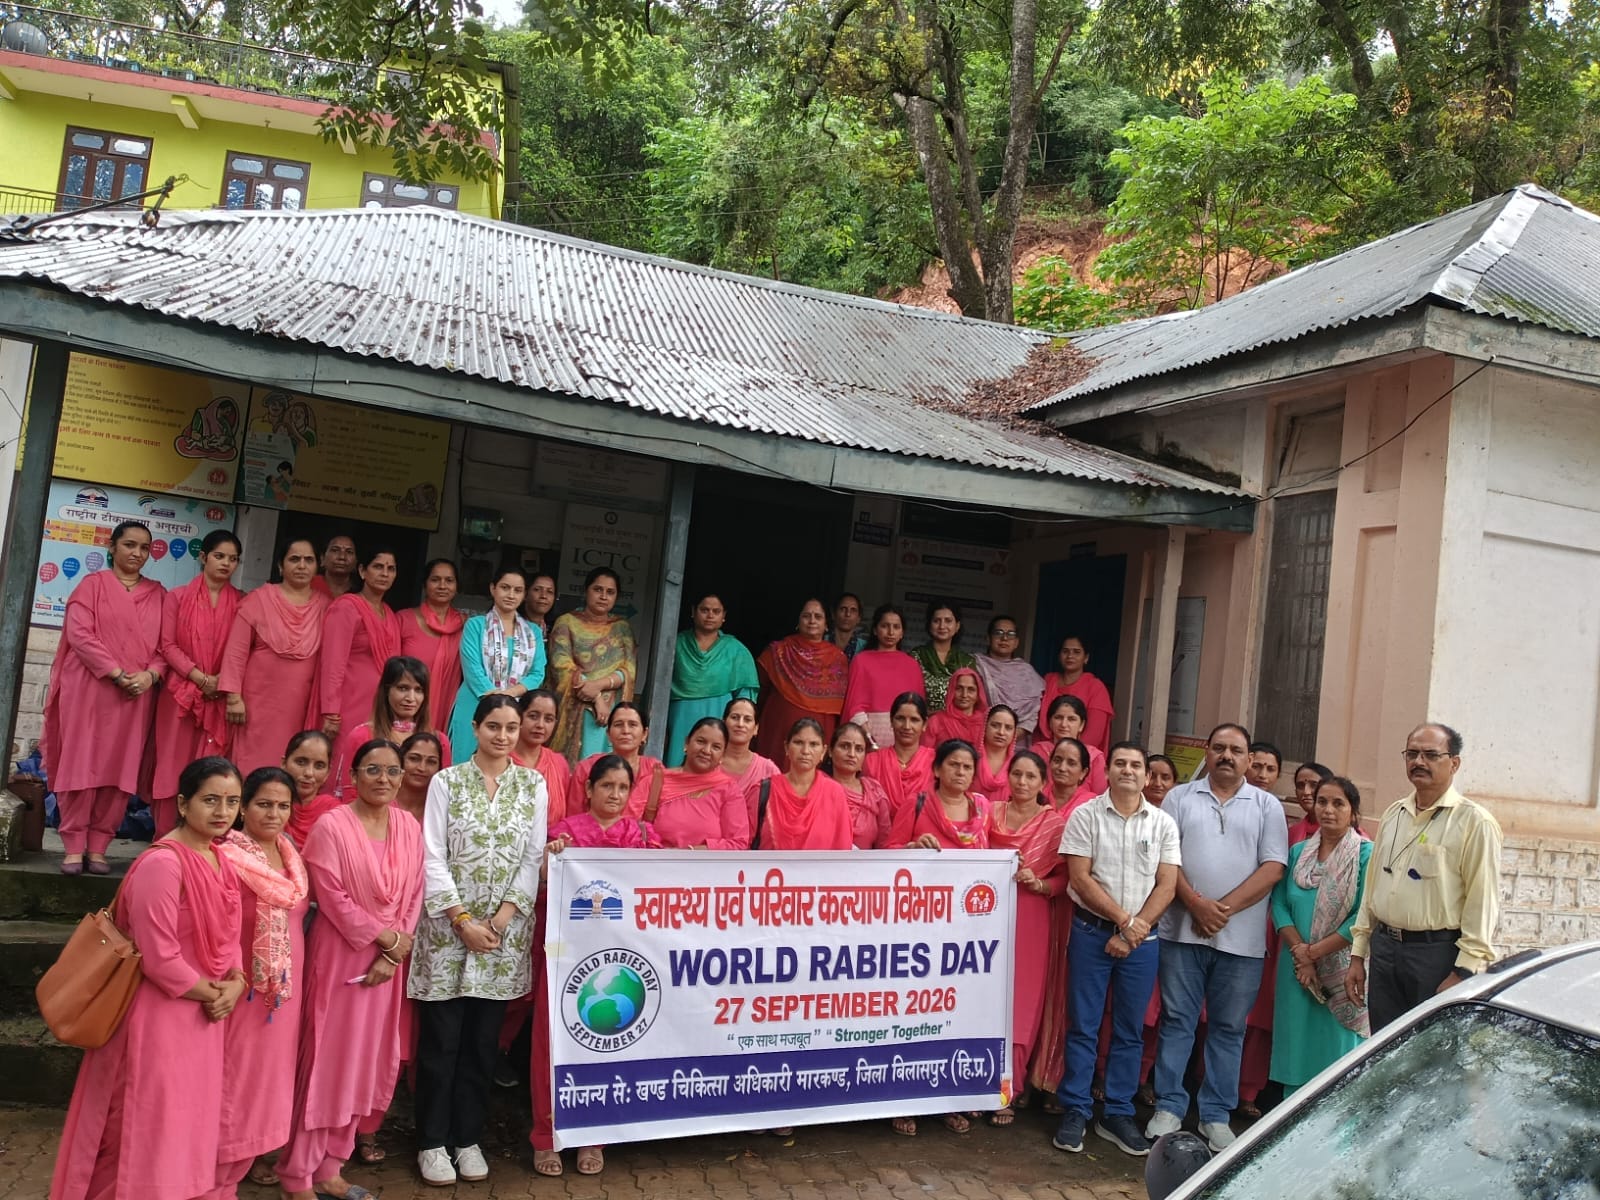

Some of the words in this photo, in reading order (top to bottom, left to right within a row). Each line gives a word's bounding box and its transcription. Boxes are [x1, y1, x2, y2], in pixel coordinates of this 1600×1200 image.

[155, 521, 192, 535] अनुसूची
[571, 547, 641, 571] ICTC
[634, 887, 710, 930] स्वास्थ्य
[714, 870, 746, 930] एवं
[749, 868, 816, 926] परिवार
[818, 886, 890, 925] कल्याण
[893, 868, 954, 924] विभाग
[566, 957, 600, 994] WORLD
[603, 951, 645, 971] RABIES
[641, 969, 658, 991] DAY
[669, 946, 798, 987] WORLD
[809, 942, 931, 981] RABIES
[940, 940, 1000, 976] DAY
[714, 998, 745, 1025] 27
[751, 991, 898, 1023] SEPTEMBER
[905, 987, 956, 1015] 2026
[570, 1022, 636, 1050] SEPTEMBER
[635, 1018, 648, 1034] 27
[834, 1026, 888, 1043] Stronger
[892, 1022, 943, 1041] Together
[559, 1072, 608, 1109] सौजन्य
[635, 1079, 669, 1101] खण्ड
[672, 1068, 730, 1099] चिकित्सा
[733, 1065, 792, 1094] अधिकारी
[796, 1067, 850, 1092] मारकण्ड,
[856, 1058, 888, 1086] जिला
[892, 1054, 948, 1088] बिलासपुर
